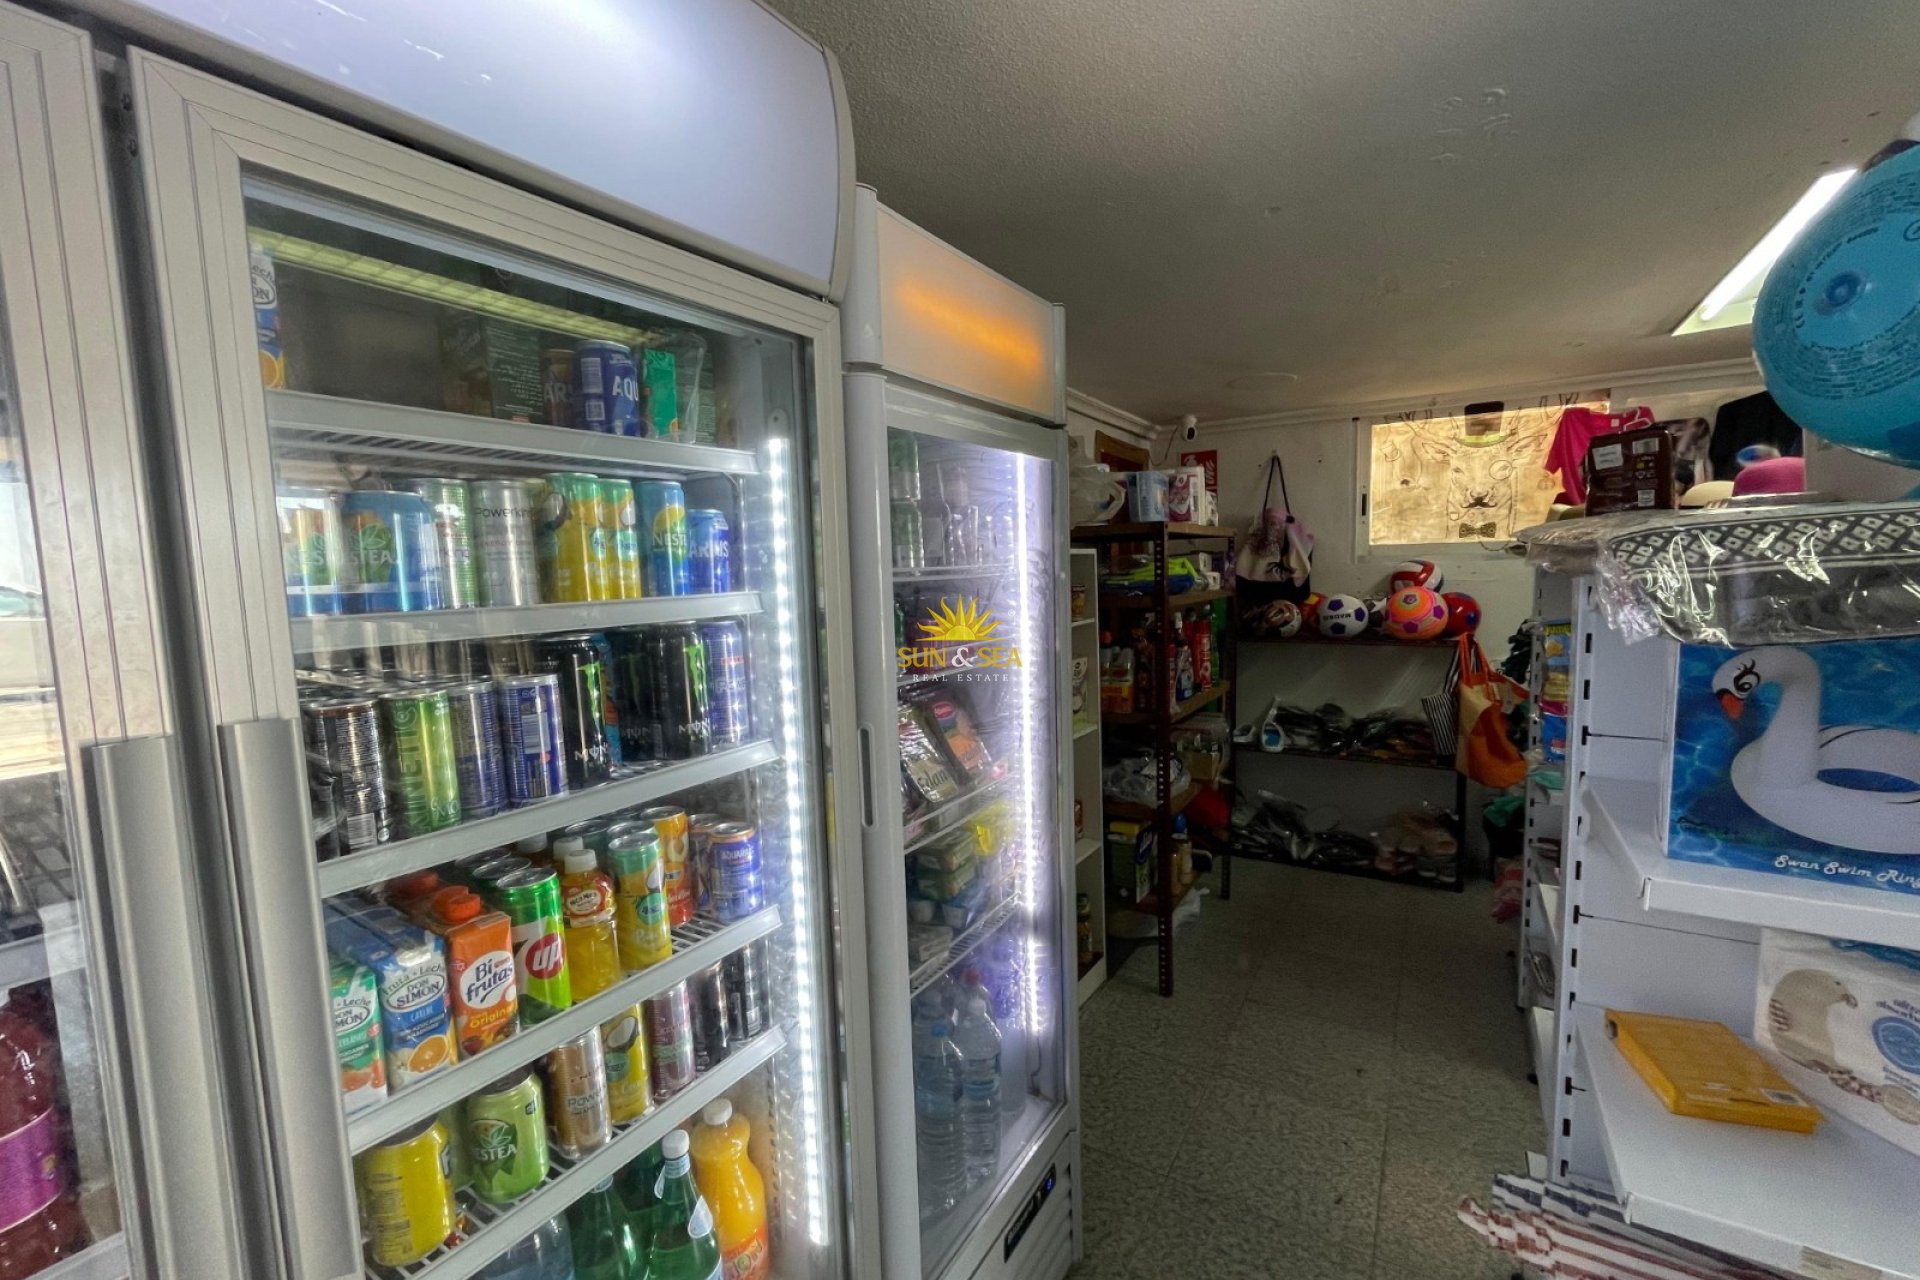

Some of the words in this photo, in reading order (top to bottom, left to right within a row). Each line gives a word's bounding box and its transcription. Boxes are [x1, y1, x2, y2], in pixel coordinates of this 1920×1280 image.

[612, 375, 639, 402] AQU
[1774, 854, 1821, 871] Swan
[1823, 861, 1873, 878] Swim
[396, 981, 442, 1008] SIMON
[406, 977, 429, 993] DON
[466, 964, 513, 1003] frutas
